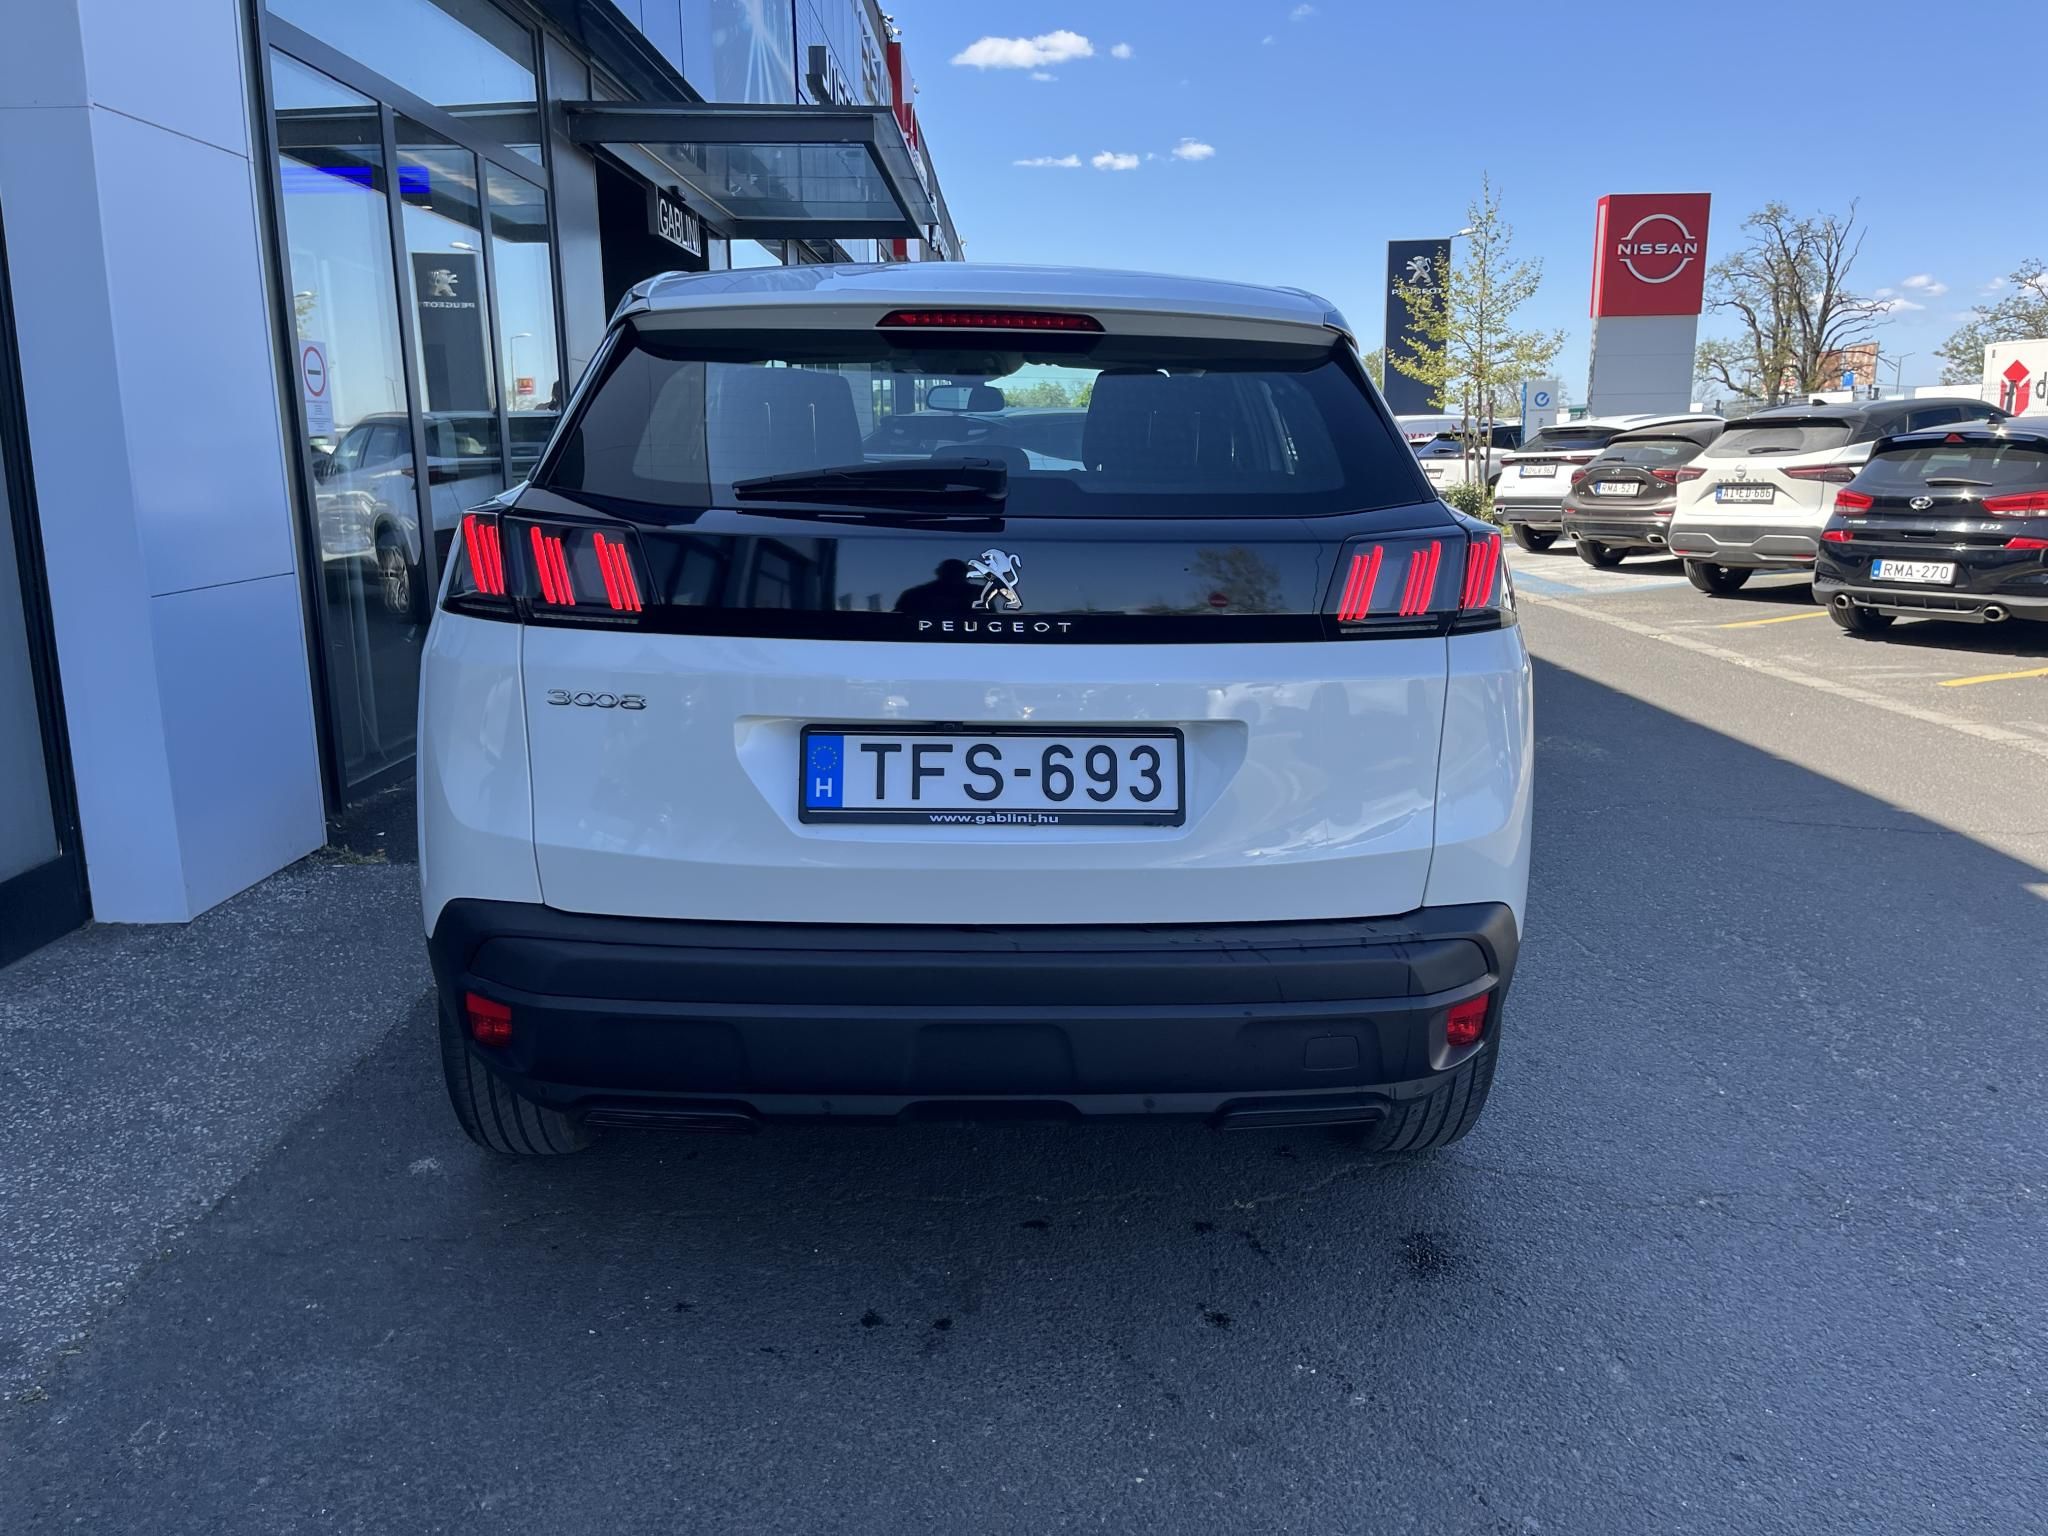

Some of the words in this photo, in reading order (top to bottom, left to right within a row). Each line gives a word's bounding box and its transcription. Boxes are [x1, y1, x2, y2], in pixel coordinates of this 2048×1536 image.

[659, 198, 701, 252] GABLINI
[1617, 242, 1698, 255] NISSAN
[1883, 563, 1949, 579] RMA-270
[918, 620, 1072, 633] PEUGEOT
[547, 688, 647, 710] 3008
[815, 777, 833, 798] H
[860, 743, 1162, 802] TFS-693
[929, 812, 1059, 825] www.gablini.hu
